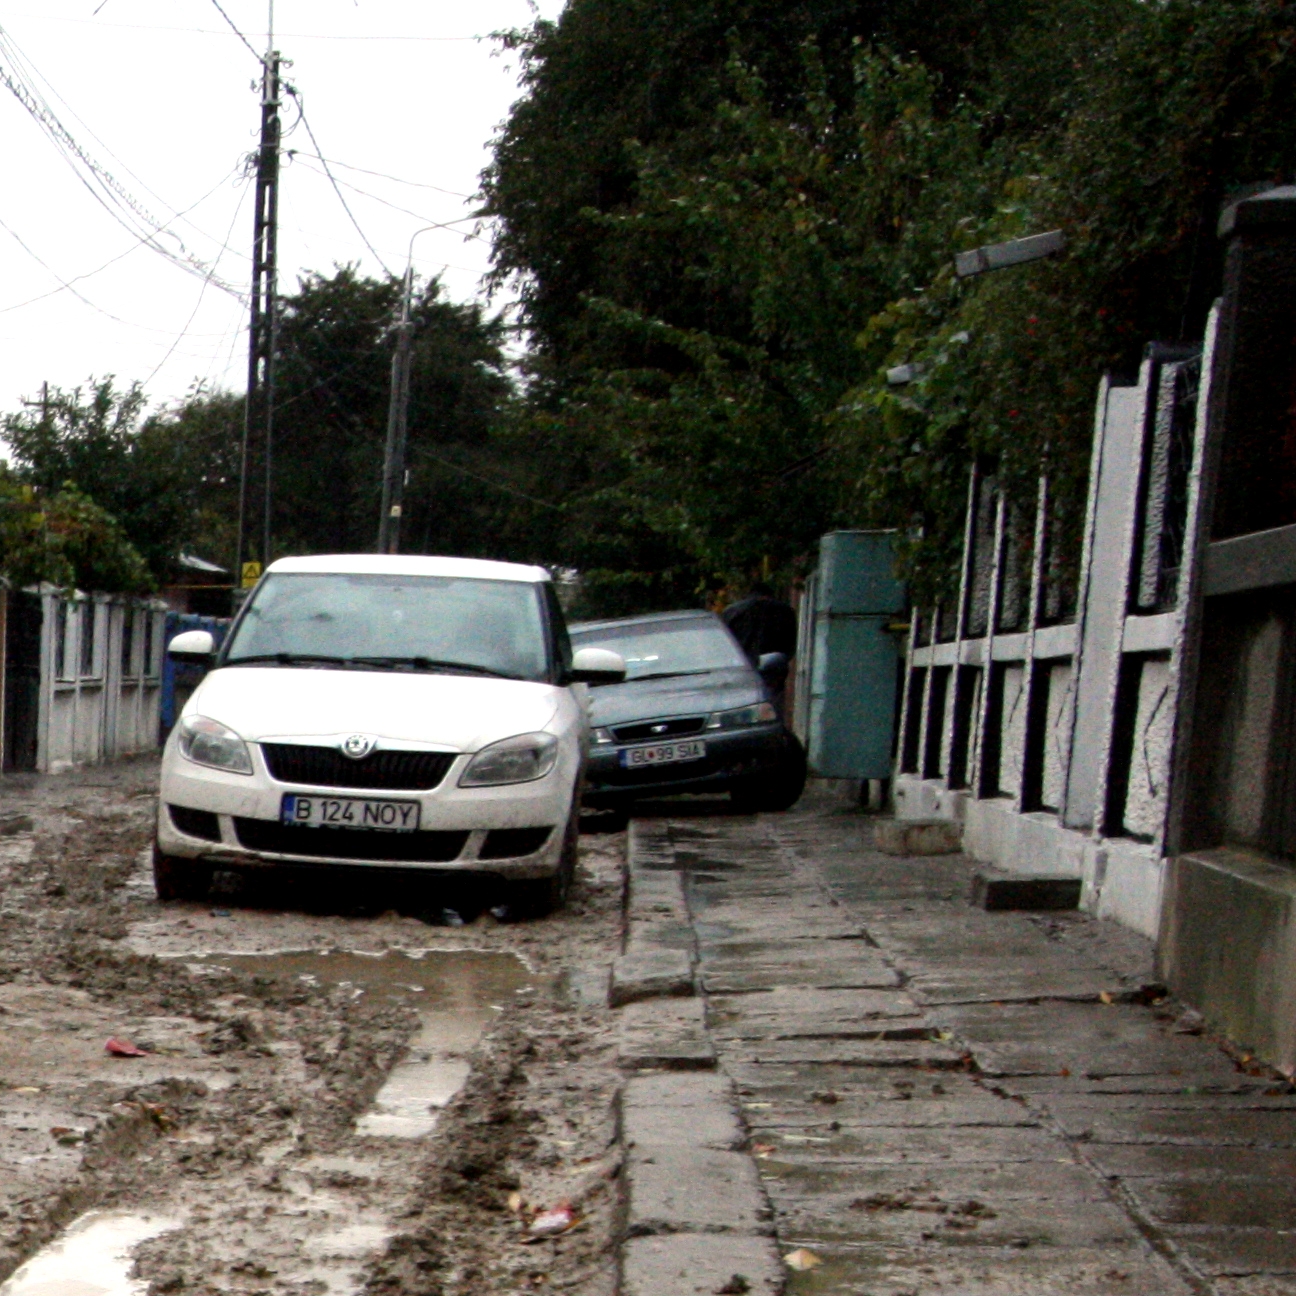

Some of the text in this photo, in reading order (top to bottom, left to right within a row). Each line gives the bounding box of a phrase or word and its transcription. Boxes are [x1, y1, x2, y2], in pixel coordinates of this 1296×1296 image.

[656, 747, 673, 761] 99
[296, 799, 412, 826] B 124 NOY
